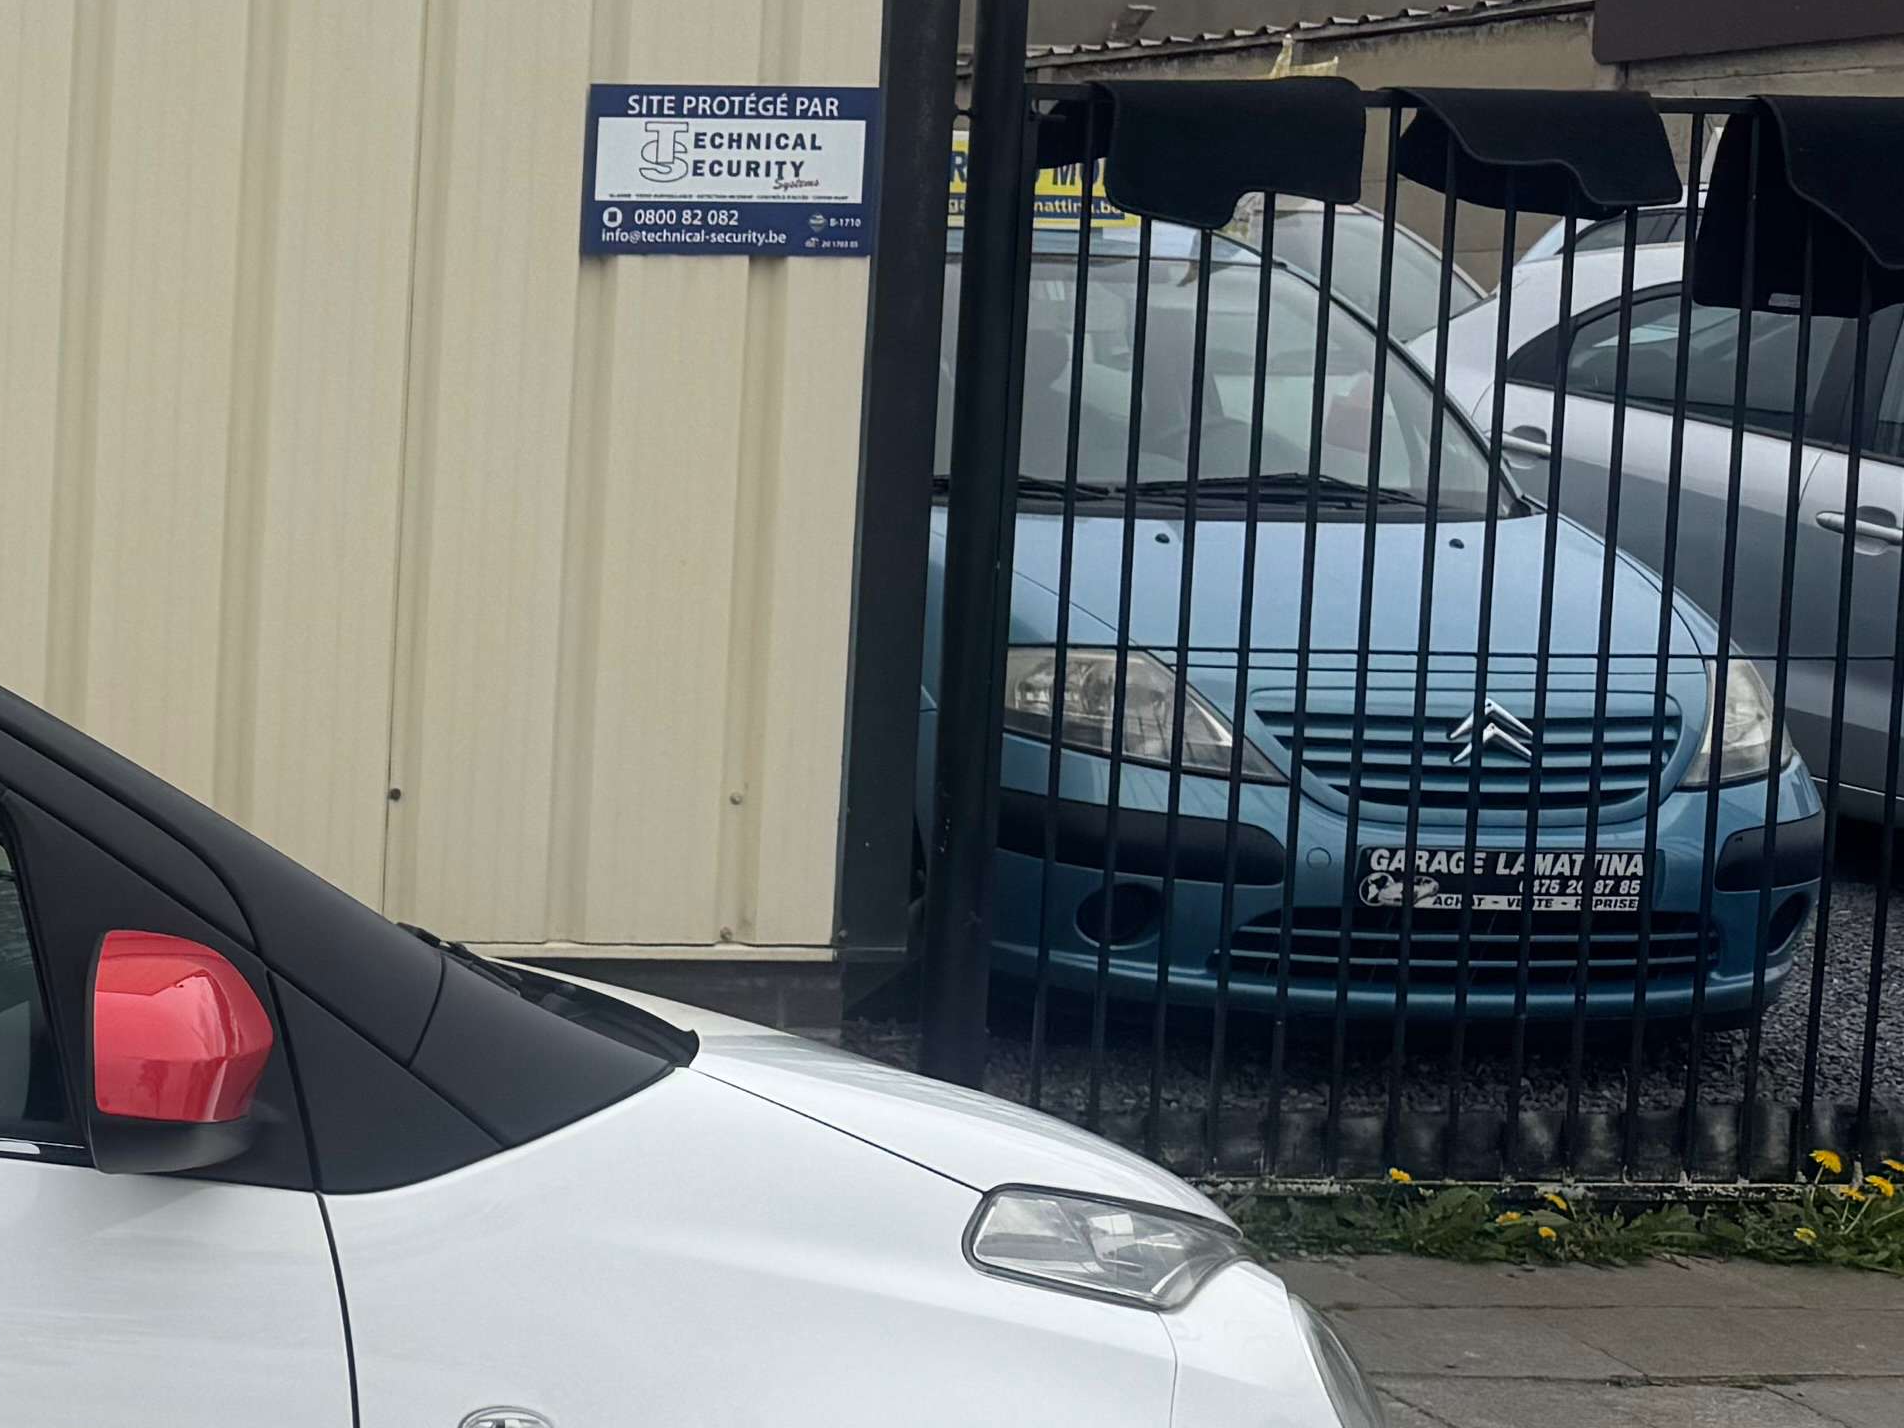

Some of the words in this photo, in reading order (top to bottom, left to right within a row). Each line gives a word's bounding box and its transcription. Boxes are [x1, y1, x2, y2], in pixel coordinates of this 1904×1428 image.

[627, 94, 676, 115] SITE
[682, 92, 789, 116] PROTÉGÉ
[795, 97, 840, 117] PAR
[634, 209, 677, 225] 0800
[681, 209, 703, 226] 82
[707, 210, 739, 226] 082
[1370, 848, 1487, 875] GARAGE
[1619, 880, 1641, 895] 85
